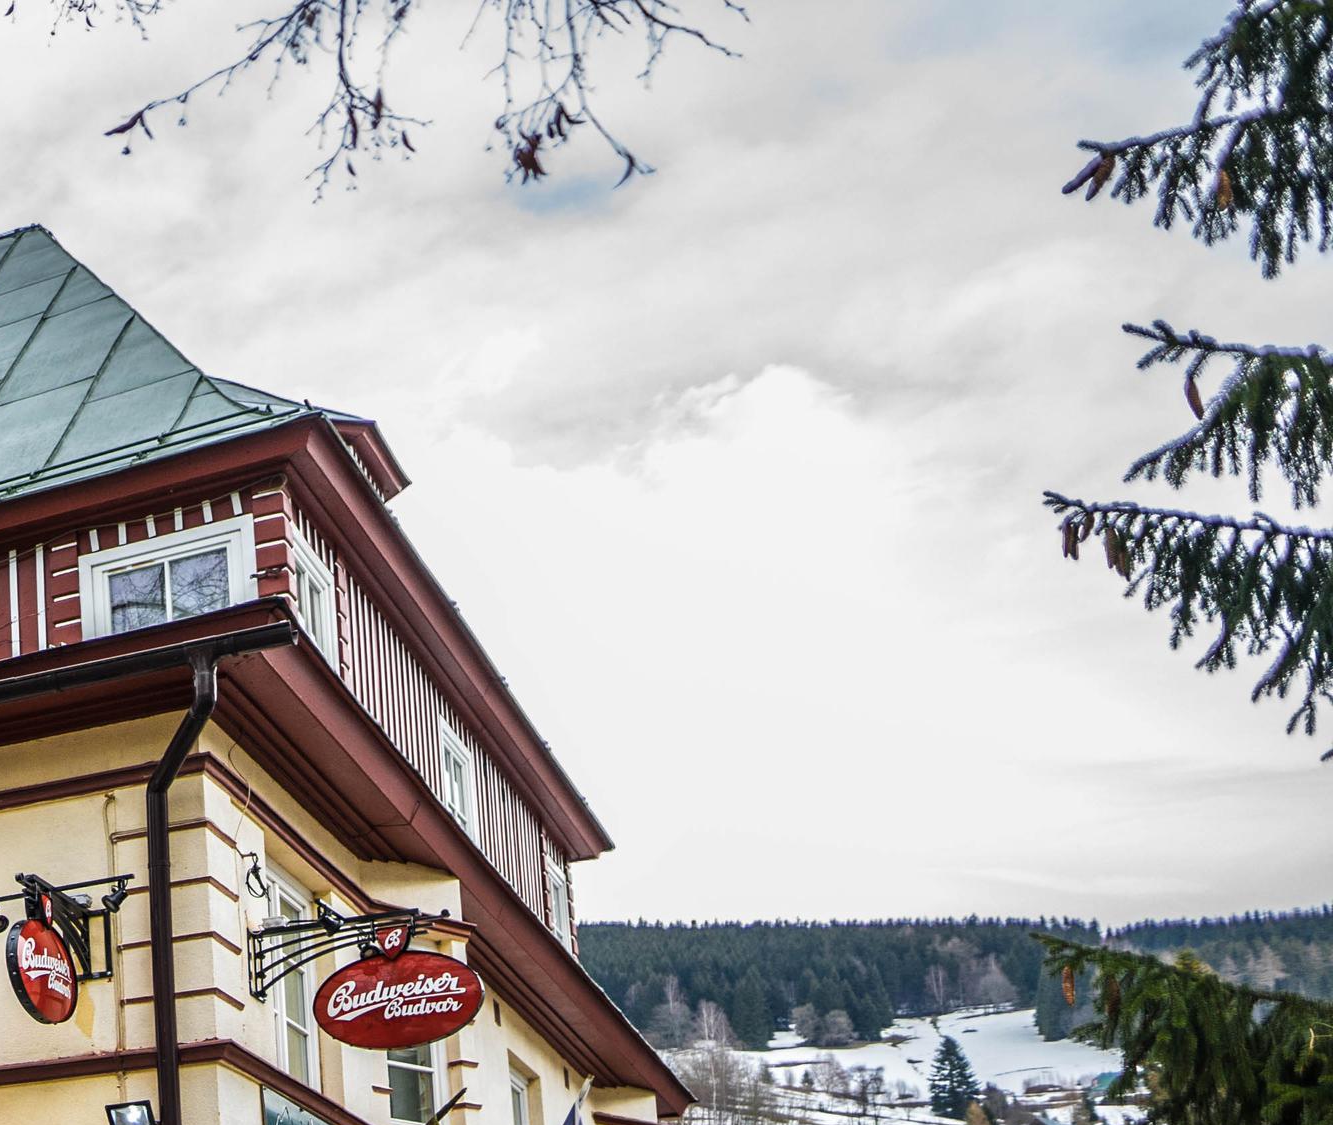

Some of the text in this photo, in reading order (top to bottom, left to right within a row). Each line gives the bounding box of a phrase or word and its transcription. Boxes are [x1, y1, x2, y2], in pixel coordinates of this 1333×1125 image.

[21, 937, 72, 980] Budweiser
[48, 969, 72, 1000] Budvar
[327, 971, 467, 1018] Budweiser
[384, 997, 463, 1020] Budvar
